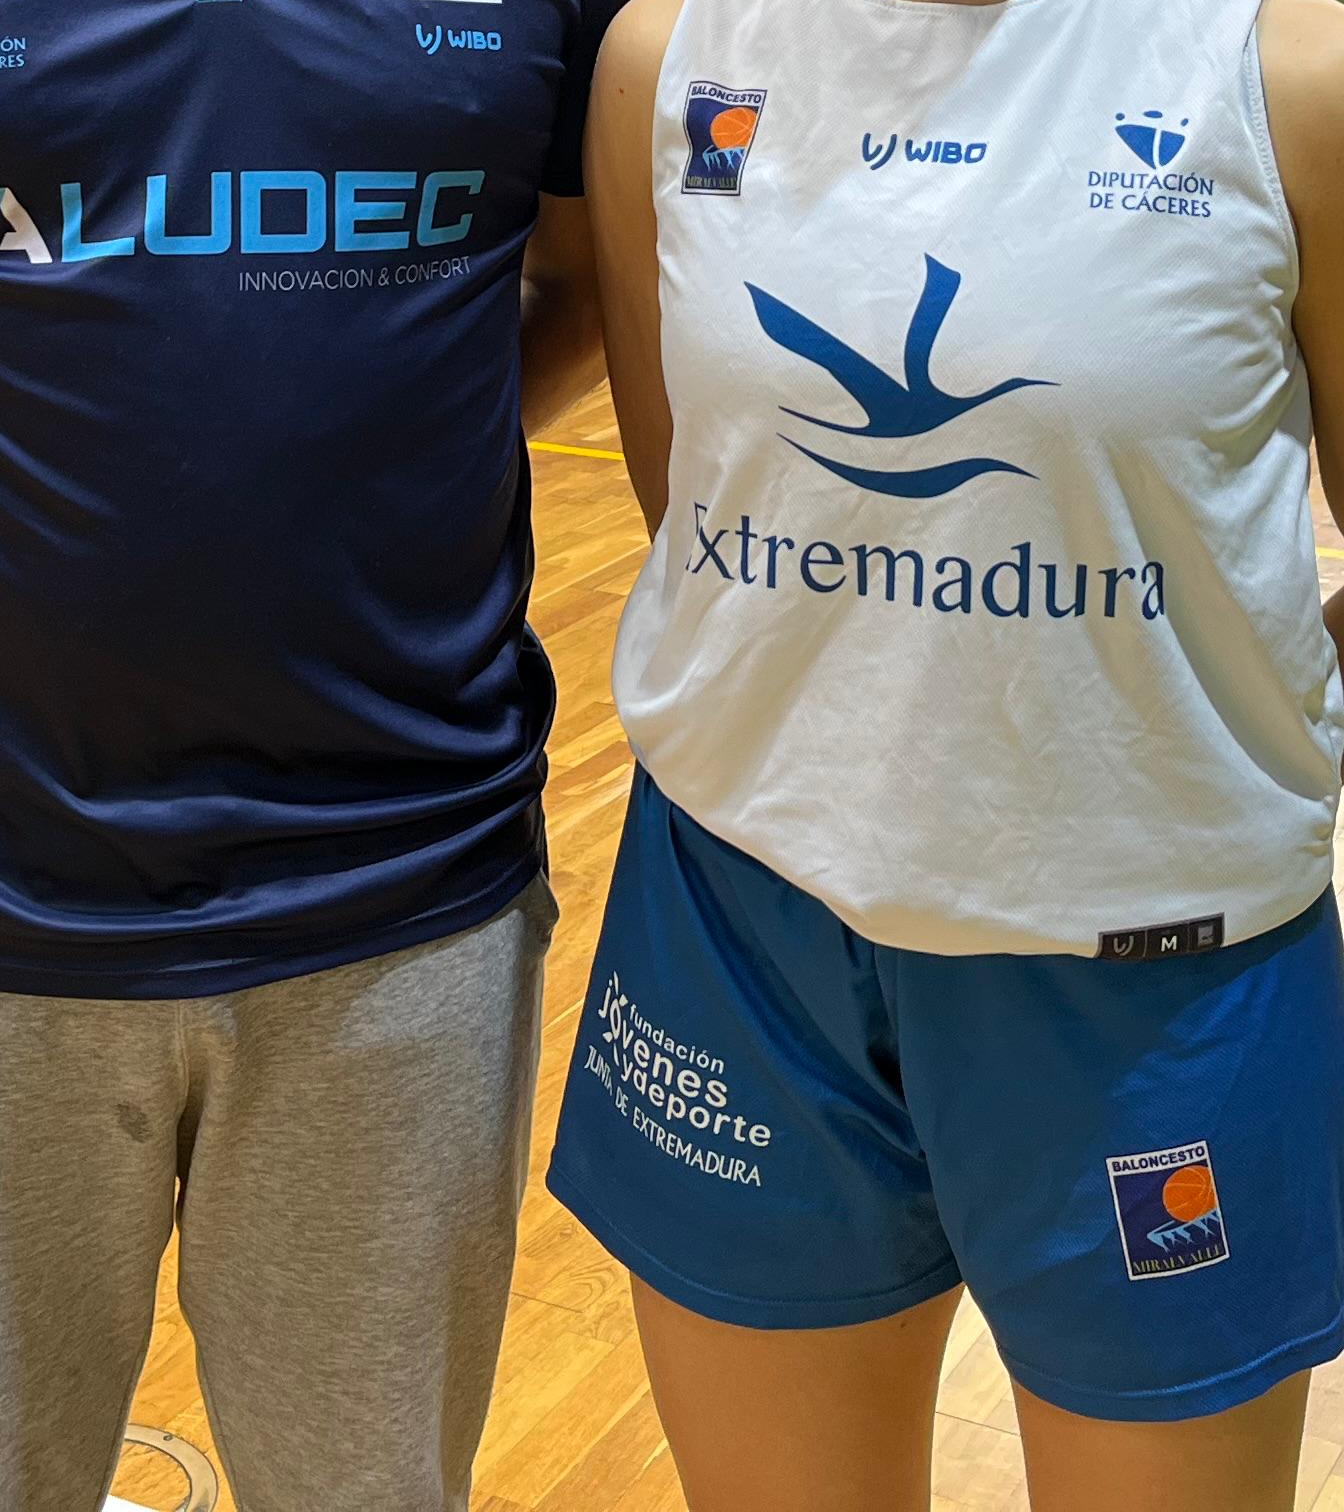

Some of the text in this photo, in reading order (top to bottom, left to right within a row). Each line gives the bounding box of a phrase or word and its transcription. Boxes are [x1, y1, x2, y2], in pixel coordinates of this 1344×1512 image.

[447, 30, 502, 51] WIBO
[690, 85, 762, 104] BALONCESTO
[904, 139, 988, 165] WIBO
[1087, 170, 1215, 198] DIPUTACIÓN
[1089, 189, 1212, 219] DE CÁCERES
[239, 254, 472, 292] INNOVACION & CONFORT
[1161, 935, 1178, 952] M
[629, 1003, 725, 1075] fundación
[583, 1044, 762, 1187] JUNTA DE EXTREMADURA
[621, 1053, 772, 1148] ydeporte
[1111, 1145, 1206, 1175] BALONCESTO
